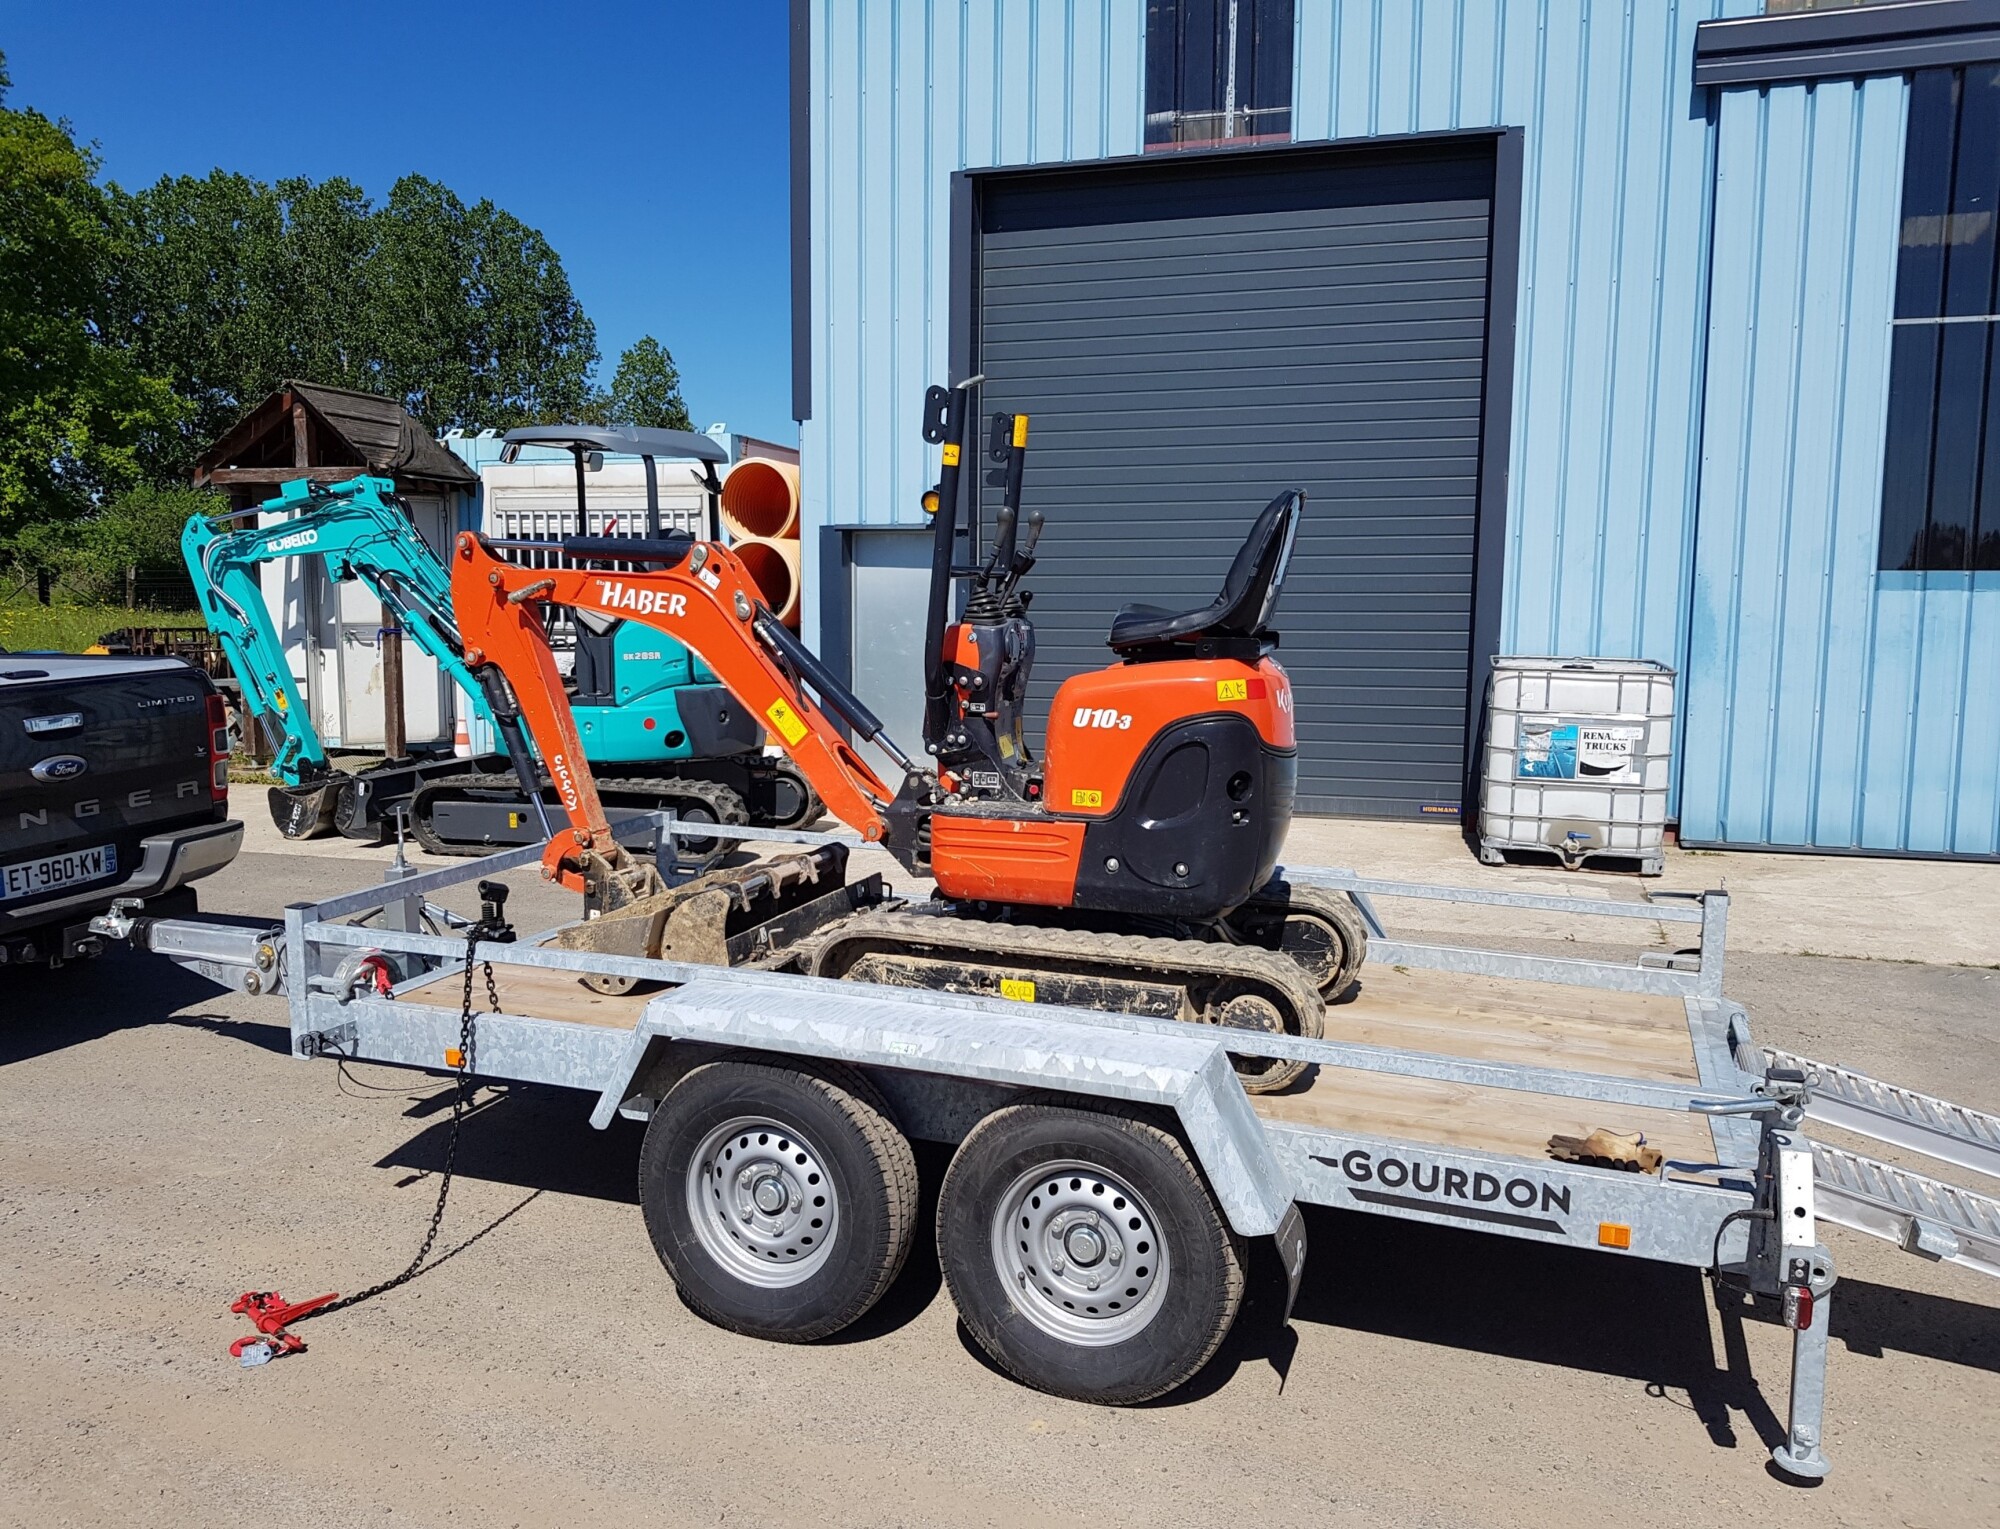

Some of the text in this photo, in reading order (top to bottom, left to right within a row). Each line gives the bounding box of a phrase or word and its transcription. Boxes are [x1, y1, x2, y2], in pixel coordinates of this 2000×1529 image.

[267, 529, 318, 553] KOBELCO
[600, 581, 687, 617] HABER
[137, 695, 195, 708] LIMITED
[1072, 707, 1132, 730] U10-3
[1583, 731, 1628, 742] RENA
[1585, 742, 1627, 751] TRUCKS
[55, 762, 78, 775] Ford
[554, 754, 578, 811] Kubota
[9, 851, 101, 892] ET-960-KW
[106, 859, 116, 870] 57
[1342, 1150, 1571, 1215] GOURDON
